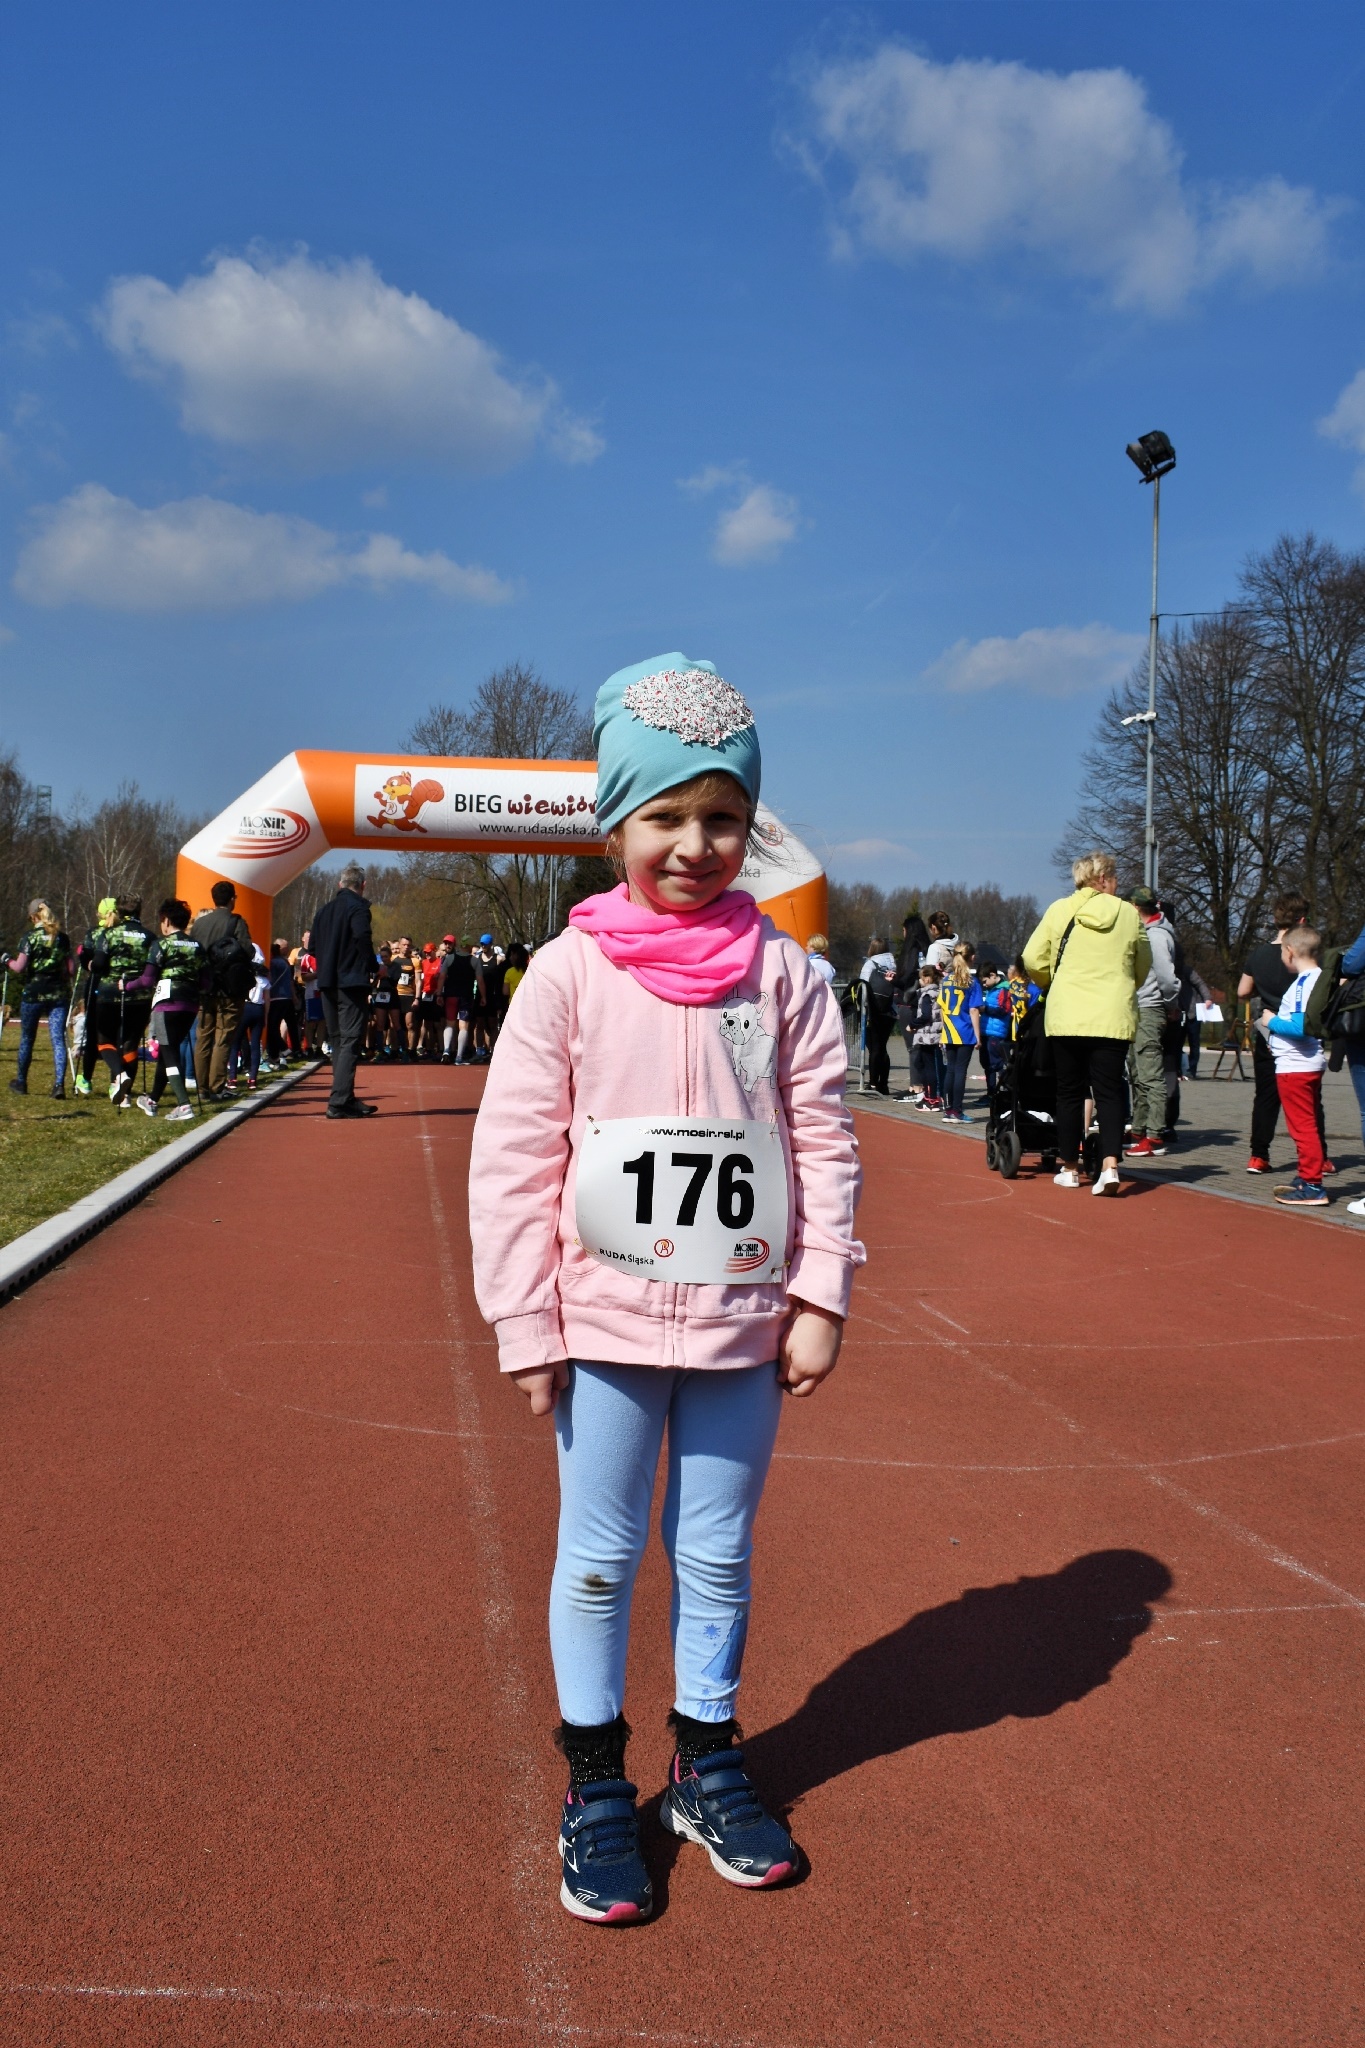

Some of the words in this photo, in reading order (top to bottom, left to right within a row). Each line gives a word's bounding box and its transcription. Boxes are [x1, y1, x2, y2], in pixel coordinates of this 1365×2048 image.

[455, 793, 502, 814] BIEG
[240, 815, 286, 830] MOSiR
[944, 987, 965, 1016] 17
[622, 1150, 755, 1230] 176
[599, 1247, 627, 1262] RUDA
[627, 1254, 655, 1265] Śląska
